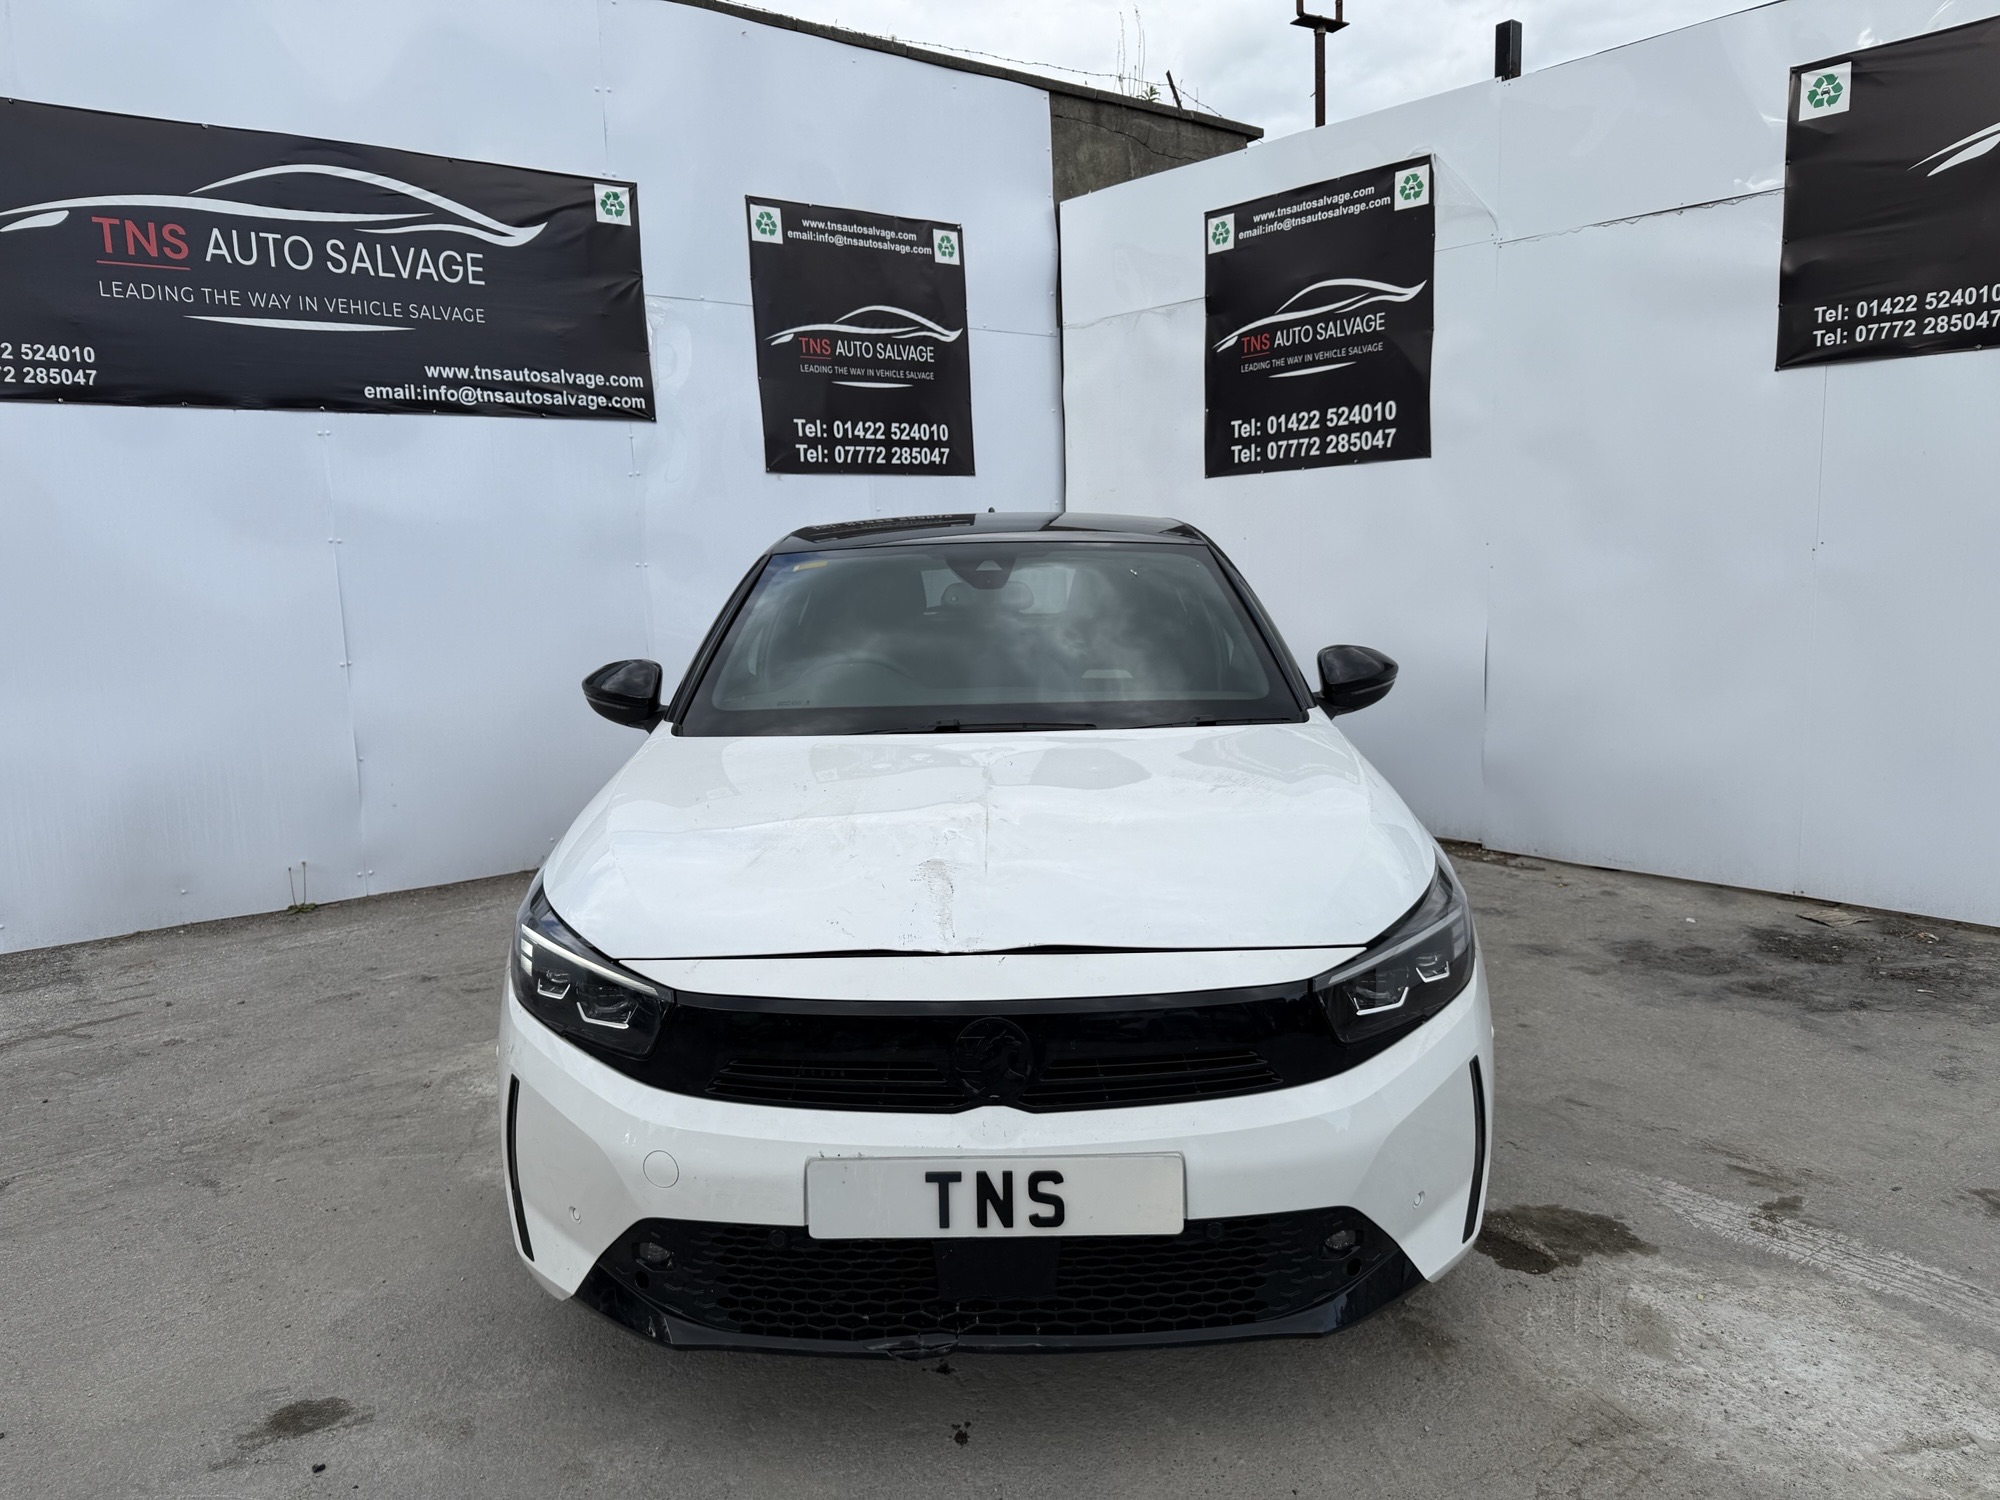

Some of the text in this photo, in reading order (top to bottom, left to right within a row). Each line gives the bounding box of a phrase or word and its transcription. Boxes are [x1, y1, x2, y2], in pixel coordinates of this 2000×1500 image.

[1238, 196, 1391, 240] email:info@tnsautosalvage.com
[1253, 186, 1374, 222] www.tnsautosalvage.com
[787, 229, 932, 255] email:info@tnsautosalvage.com
[802, 219, 916, 241] www.tnsautosalvage.com
[91, 216, 486, 286] TNS AUTO SALVAGE
[99, 280, 486, 324] LEADING THE WAY IN VEHICLE SALVAGE
[1814, 283, 2000, 324] Tel: 01422 524010
[1241, 312, 1386, 354] TNS AUTO SALVAGE
[1812, 310, 2000, 347] Tel: 07772 285047
[21, 343, 96, 363] 524010
[799, 337, 935, 362] TNS AUTO SALVAGE
[1240, 342, 1383, 373] LEADING THE WAY IN VEHICLE SALVAGE
[0, 365, 98, 386] 2 285047
[424, 364, 644, 389] www.tnsautosalvage.com
[800, 364, 935, 381] LEADING THE WAY IN VEHICLE SALVAGE
[363, 383, 646, 411] email:info@tnsautosalvage.com
[793, 418, 949, 441] Tel: 01422 524010
[1230, 400, 1397, 439] Tel: 01422 524010
[795, 443, 950, 465] Tel: 07772 285047
[1230, 427, 1397, 464] Tel: 07772 285047
[925, 1170, 1065, 1229] TNS
